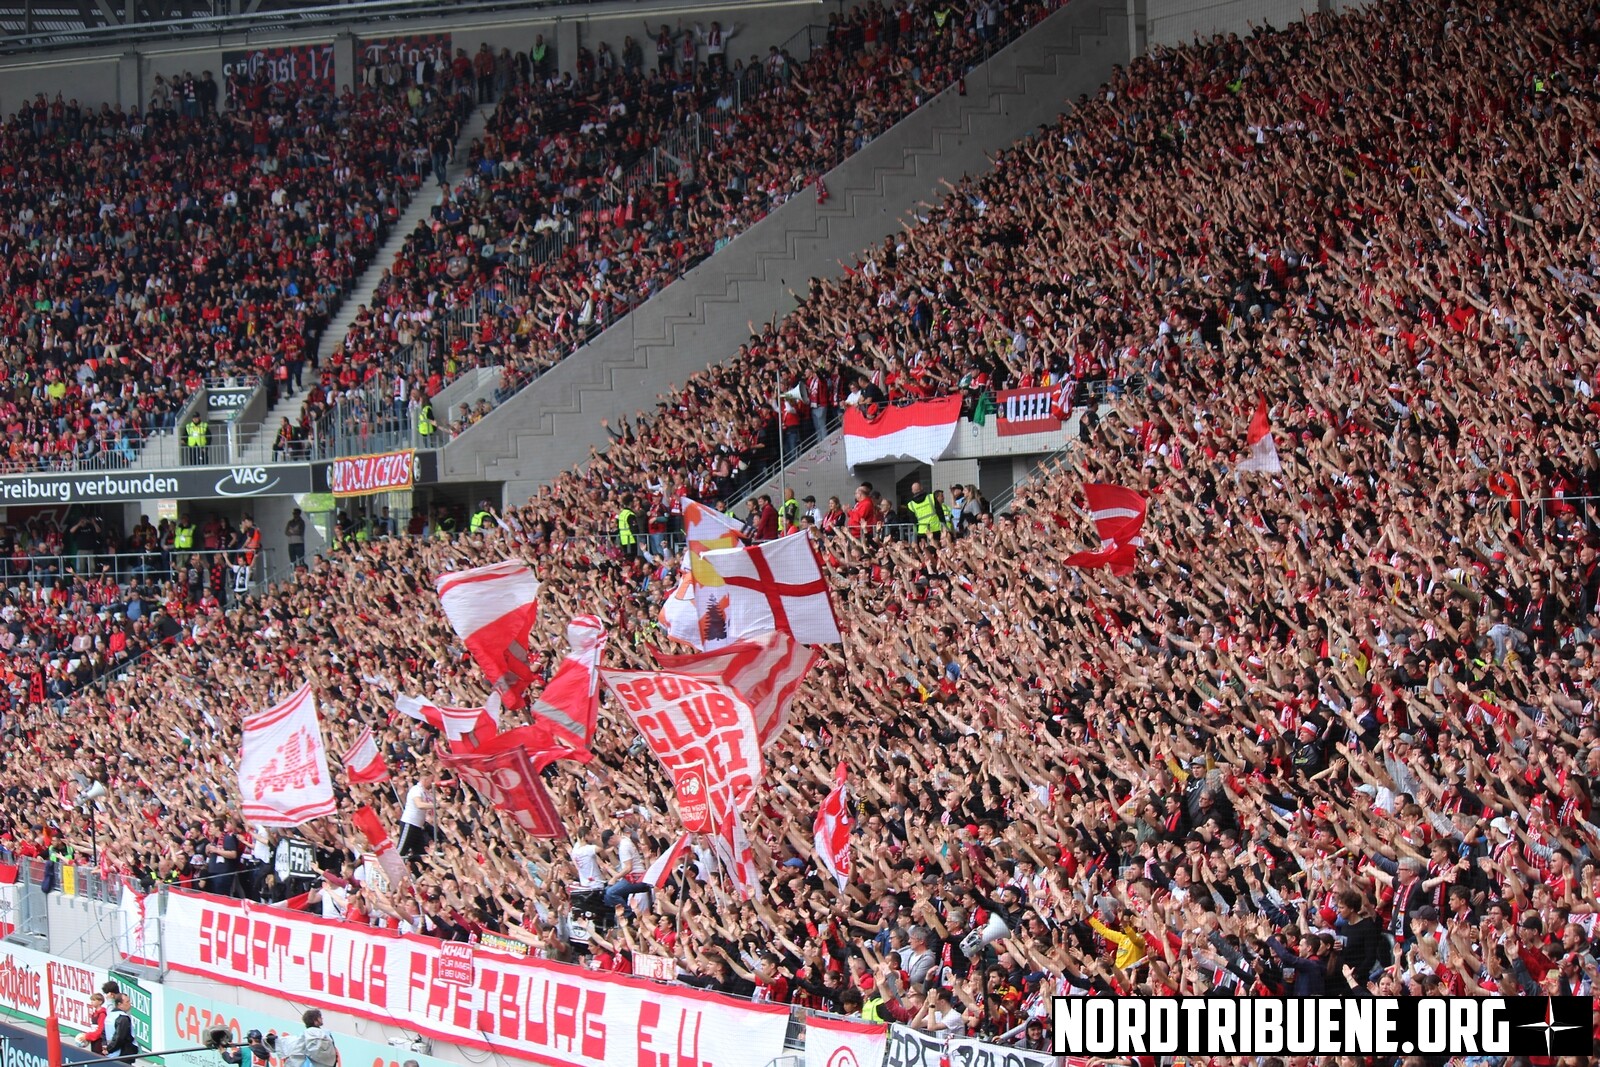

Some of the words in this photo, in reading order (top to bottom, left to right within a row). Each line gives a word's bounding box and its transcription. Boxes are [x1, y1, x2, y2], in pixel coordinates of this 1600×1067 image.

[249, 51, 298, 83] East
[310, 47, 334, 80] 17
[75, 474, 178, 496] verbunden
[231, 467, 268, 485] VAG
[636, 692, 740, 754] CLUB
[199, 908, 388, 1009] SPORT-CLUB
[50, 961, 95, 995] TANNEN
